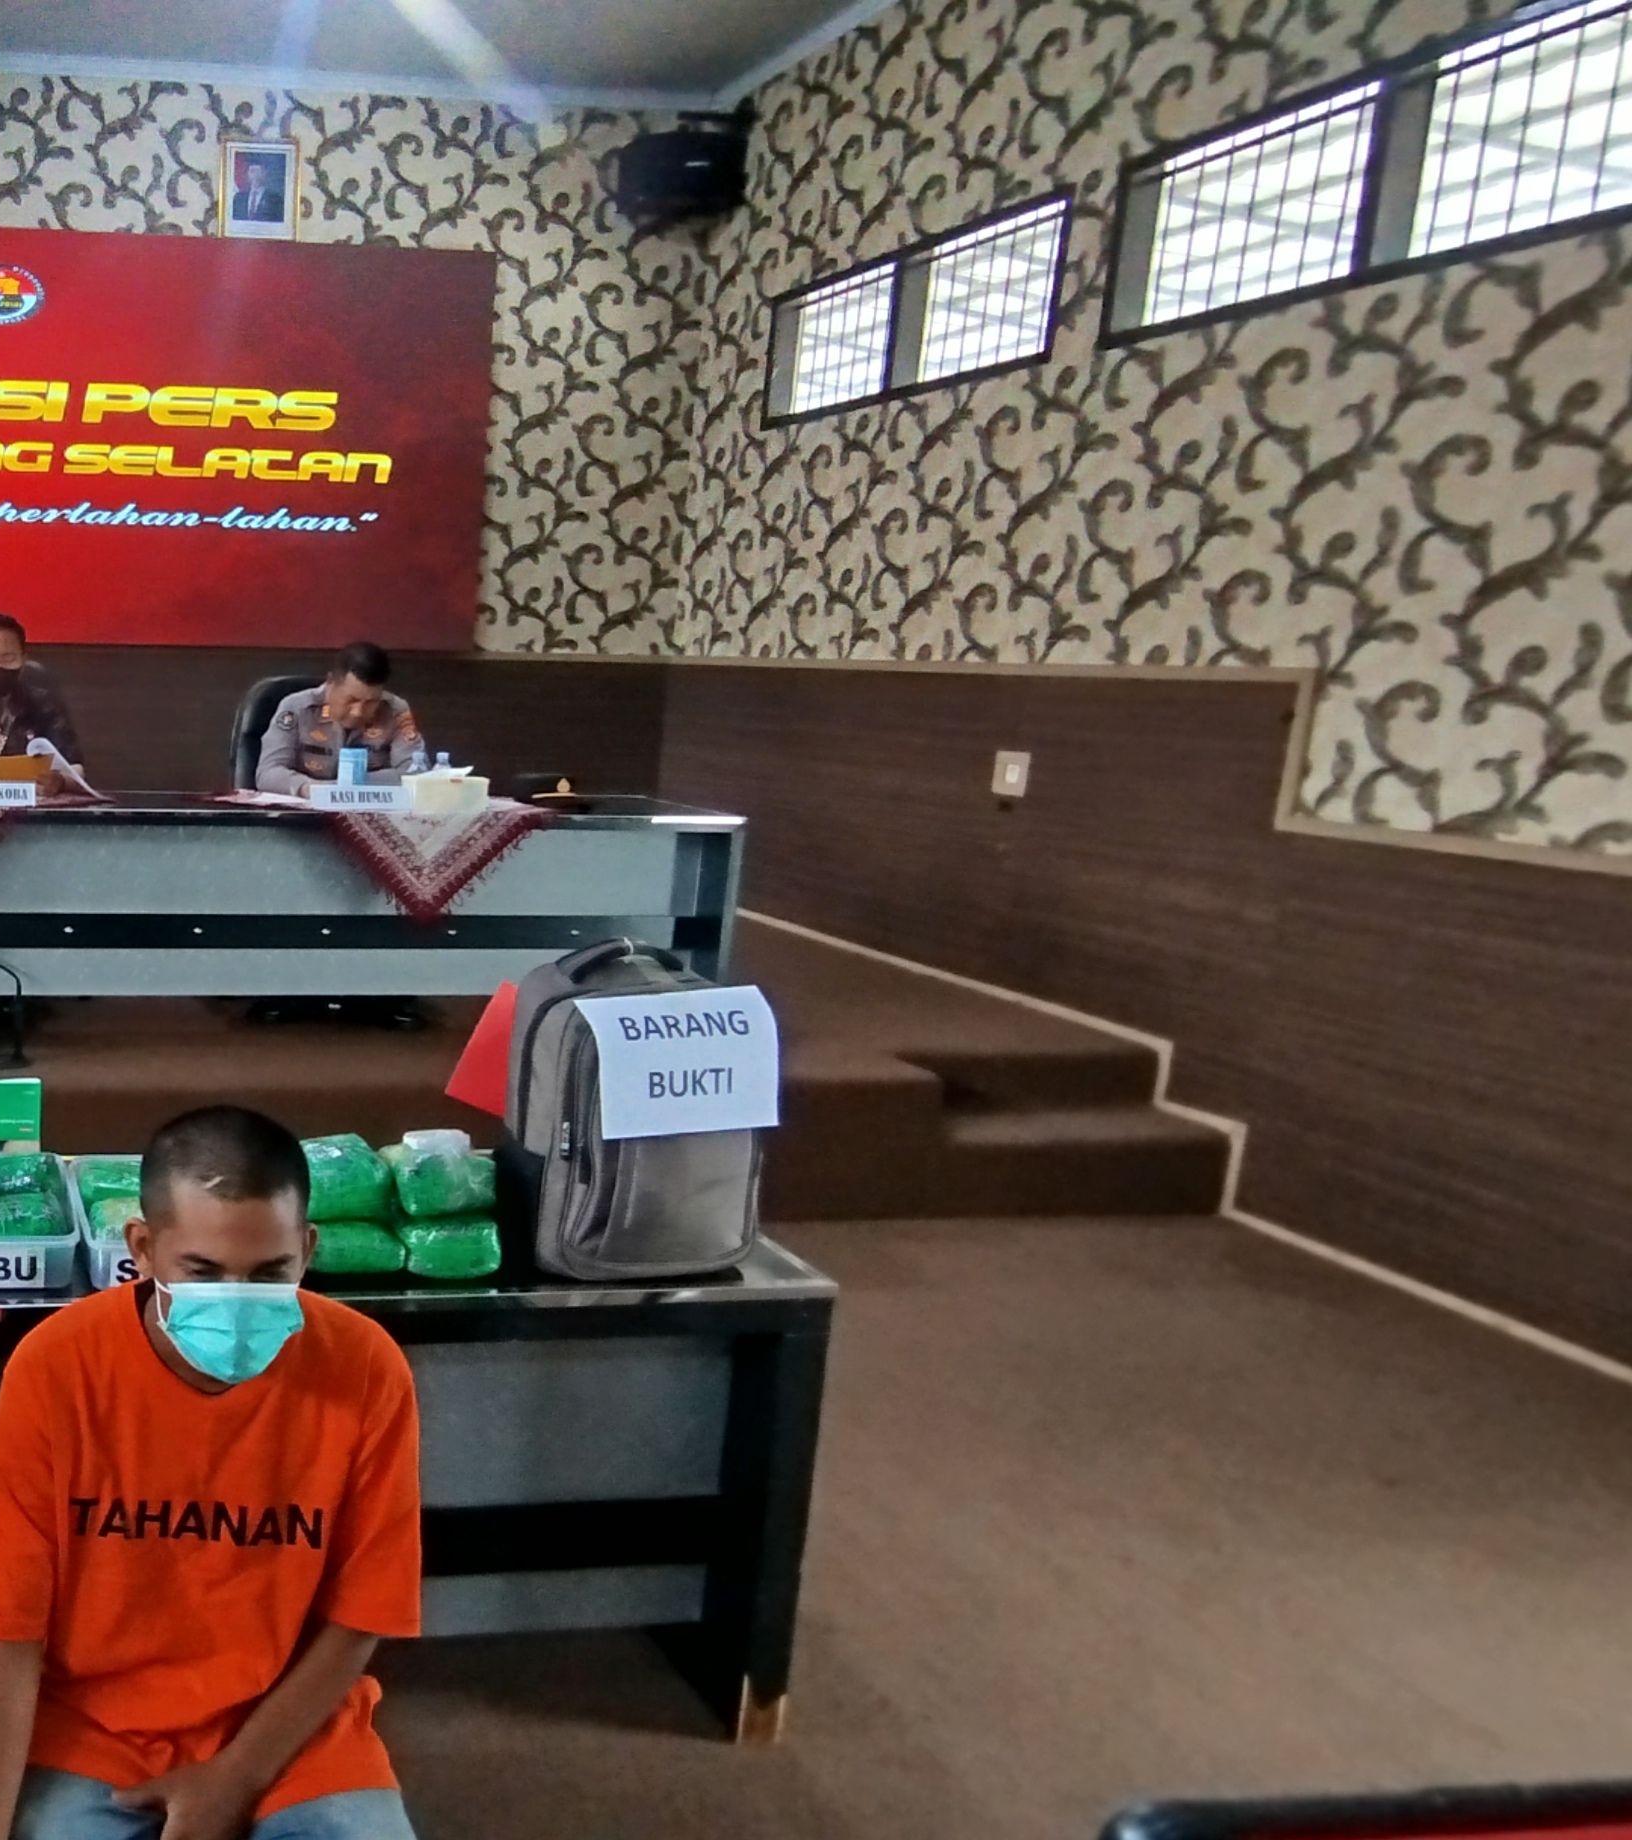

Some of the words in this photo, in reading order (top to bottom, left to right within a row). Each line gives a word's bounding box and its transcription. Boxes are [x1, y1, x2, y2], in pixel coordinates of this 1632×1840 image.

[81, 382, 339, 432] PERS
[63, 443, 394, 484] SELATAN
[330, 790, 355, 803] KASI
[358, 791, 394, 803] HUMAS
[618, 1010, 750, 1041] BARANG
[649, 1067, 733, 1099] BUKTI
[68, 1497, 323, 1550] TAHANAN
